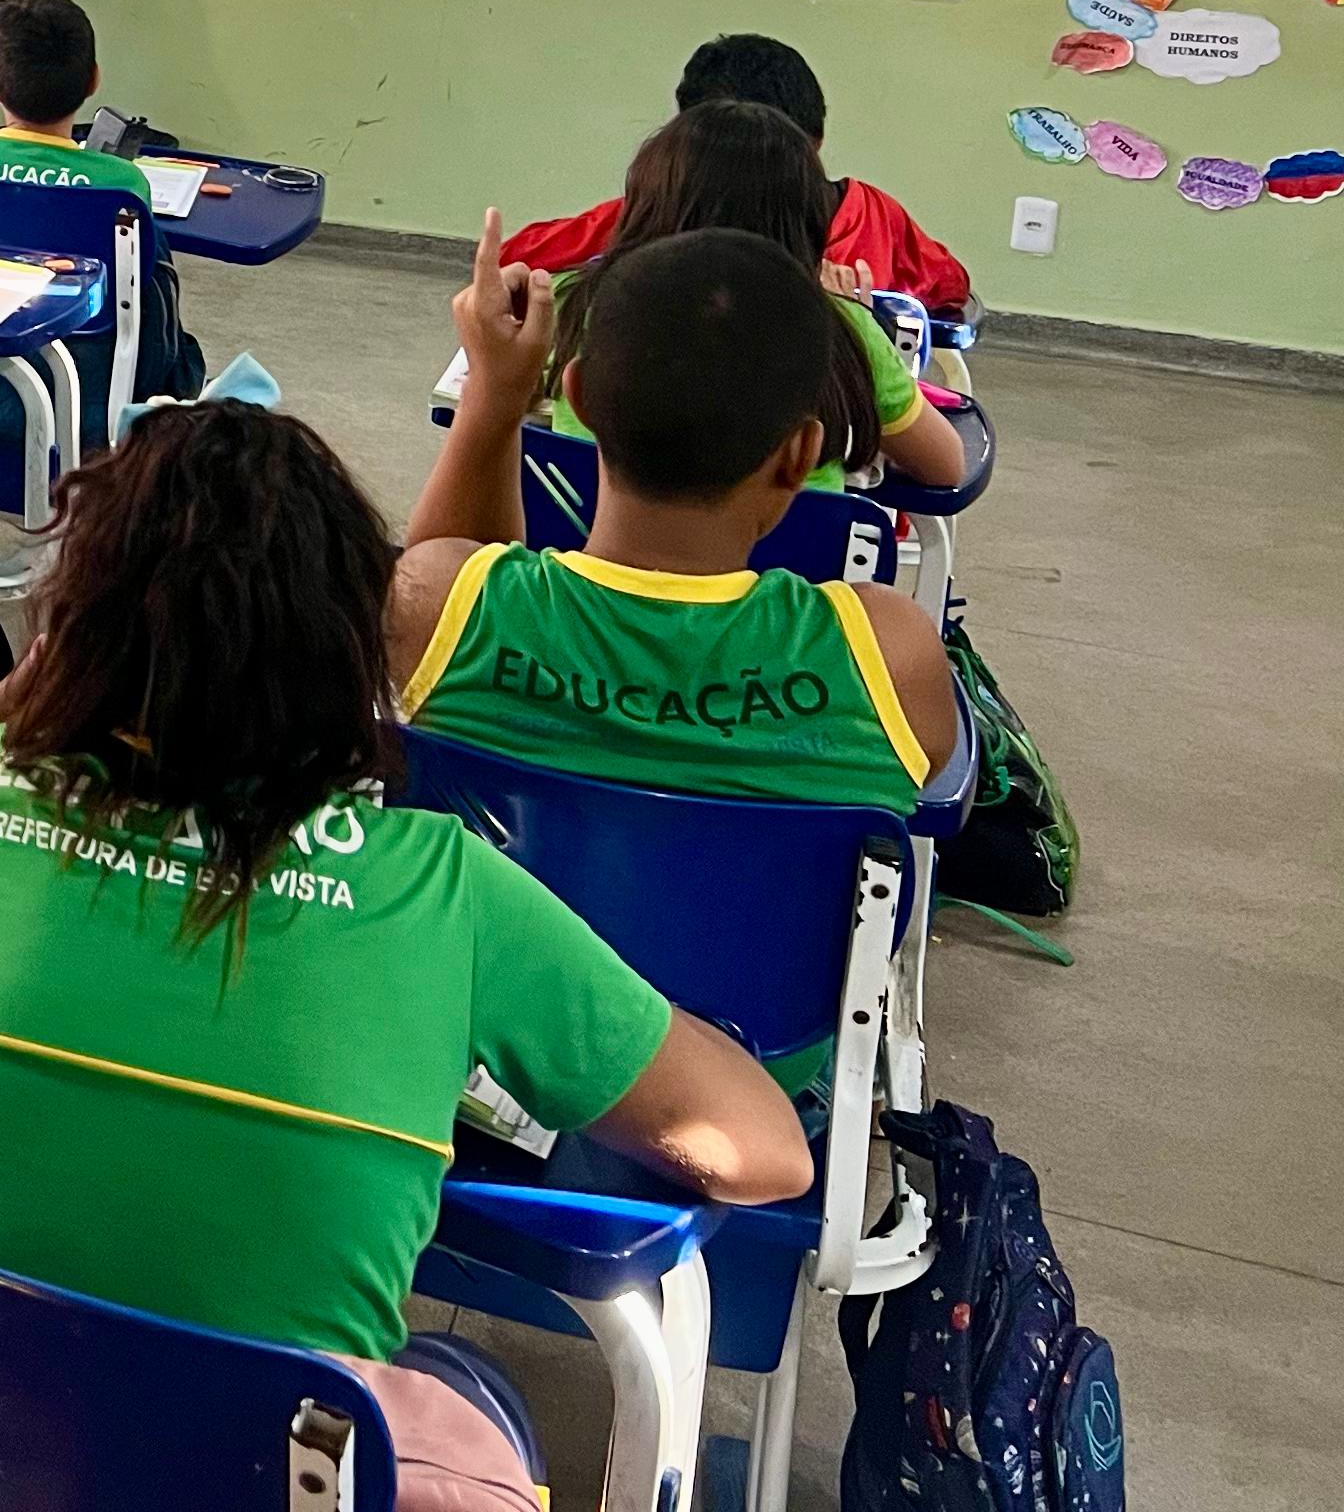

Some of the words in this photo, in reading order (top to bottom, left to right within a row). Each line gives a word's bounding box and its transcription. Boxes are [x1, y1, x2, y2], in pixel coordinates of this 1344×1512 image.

[1168, 46, 1239, 59] HUMANOS
[1170, 32, 1239, 46] DIREITOS
[1027, 109, 1077, 156] TRABALHO
[1112, 136, 1140, 162] VIDA
[492, 647, 830, 738] EDUCAÇÃO
[145, 854, 187, 887] DE
[271, 869, 355, 910] VISTA
